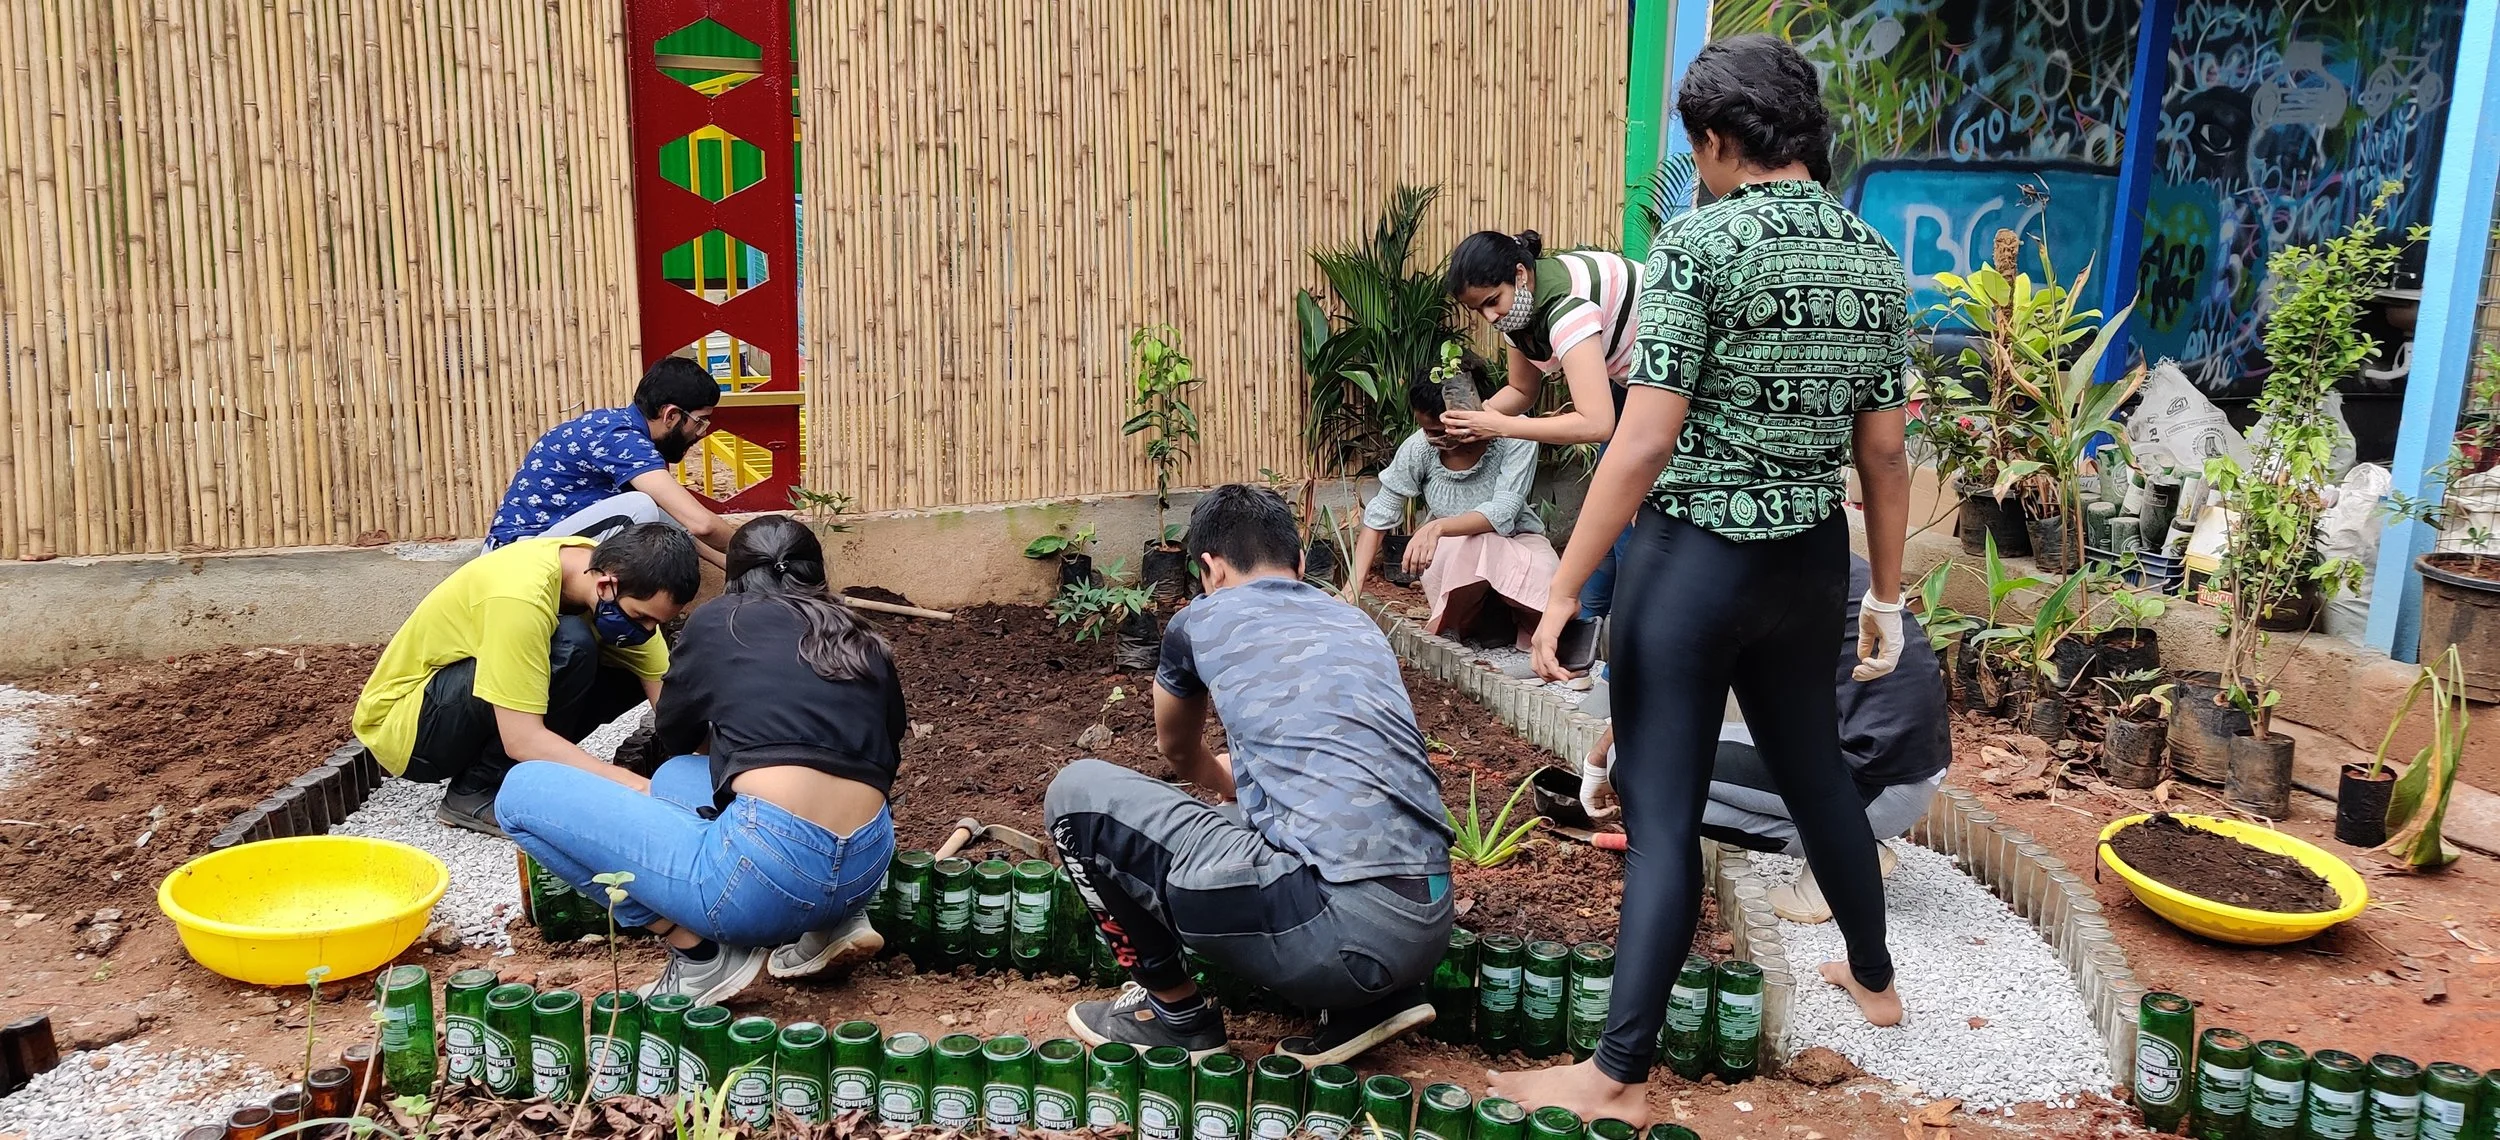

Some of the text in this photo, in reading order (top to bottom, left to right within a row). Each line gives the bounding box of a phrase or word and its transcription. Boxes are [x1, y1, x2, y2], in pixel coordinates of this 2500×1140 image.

[2200, 588, 2235, 607] HERCU
[445, 1043, 484, 1057] Heinek
[532, 1063, 567, 1077] Heinek
[638, 1064, 670, 1078] Heinek
[2137, 1062, 2178, 1079] Heinek
